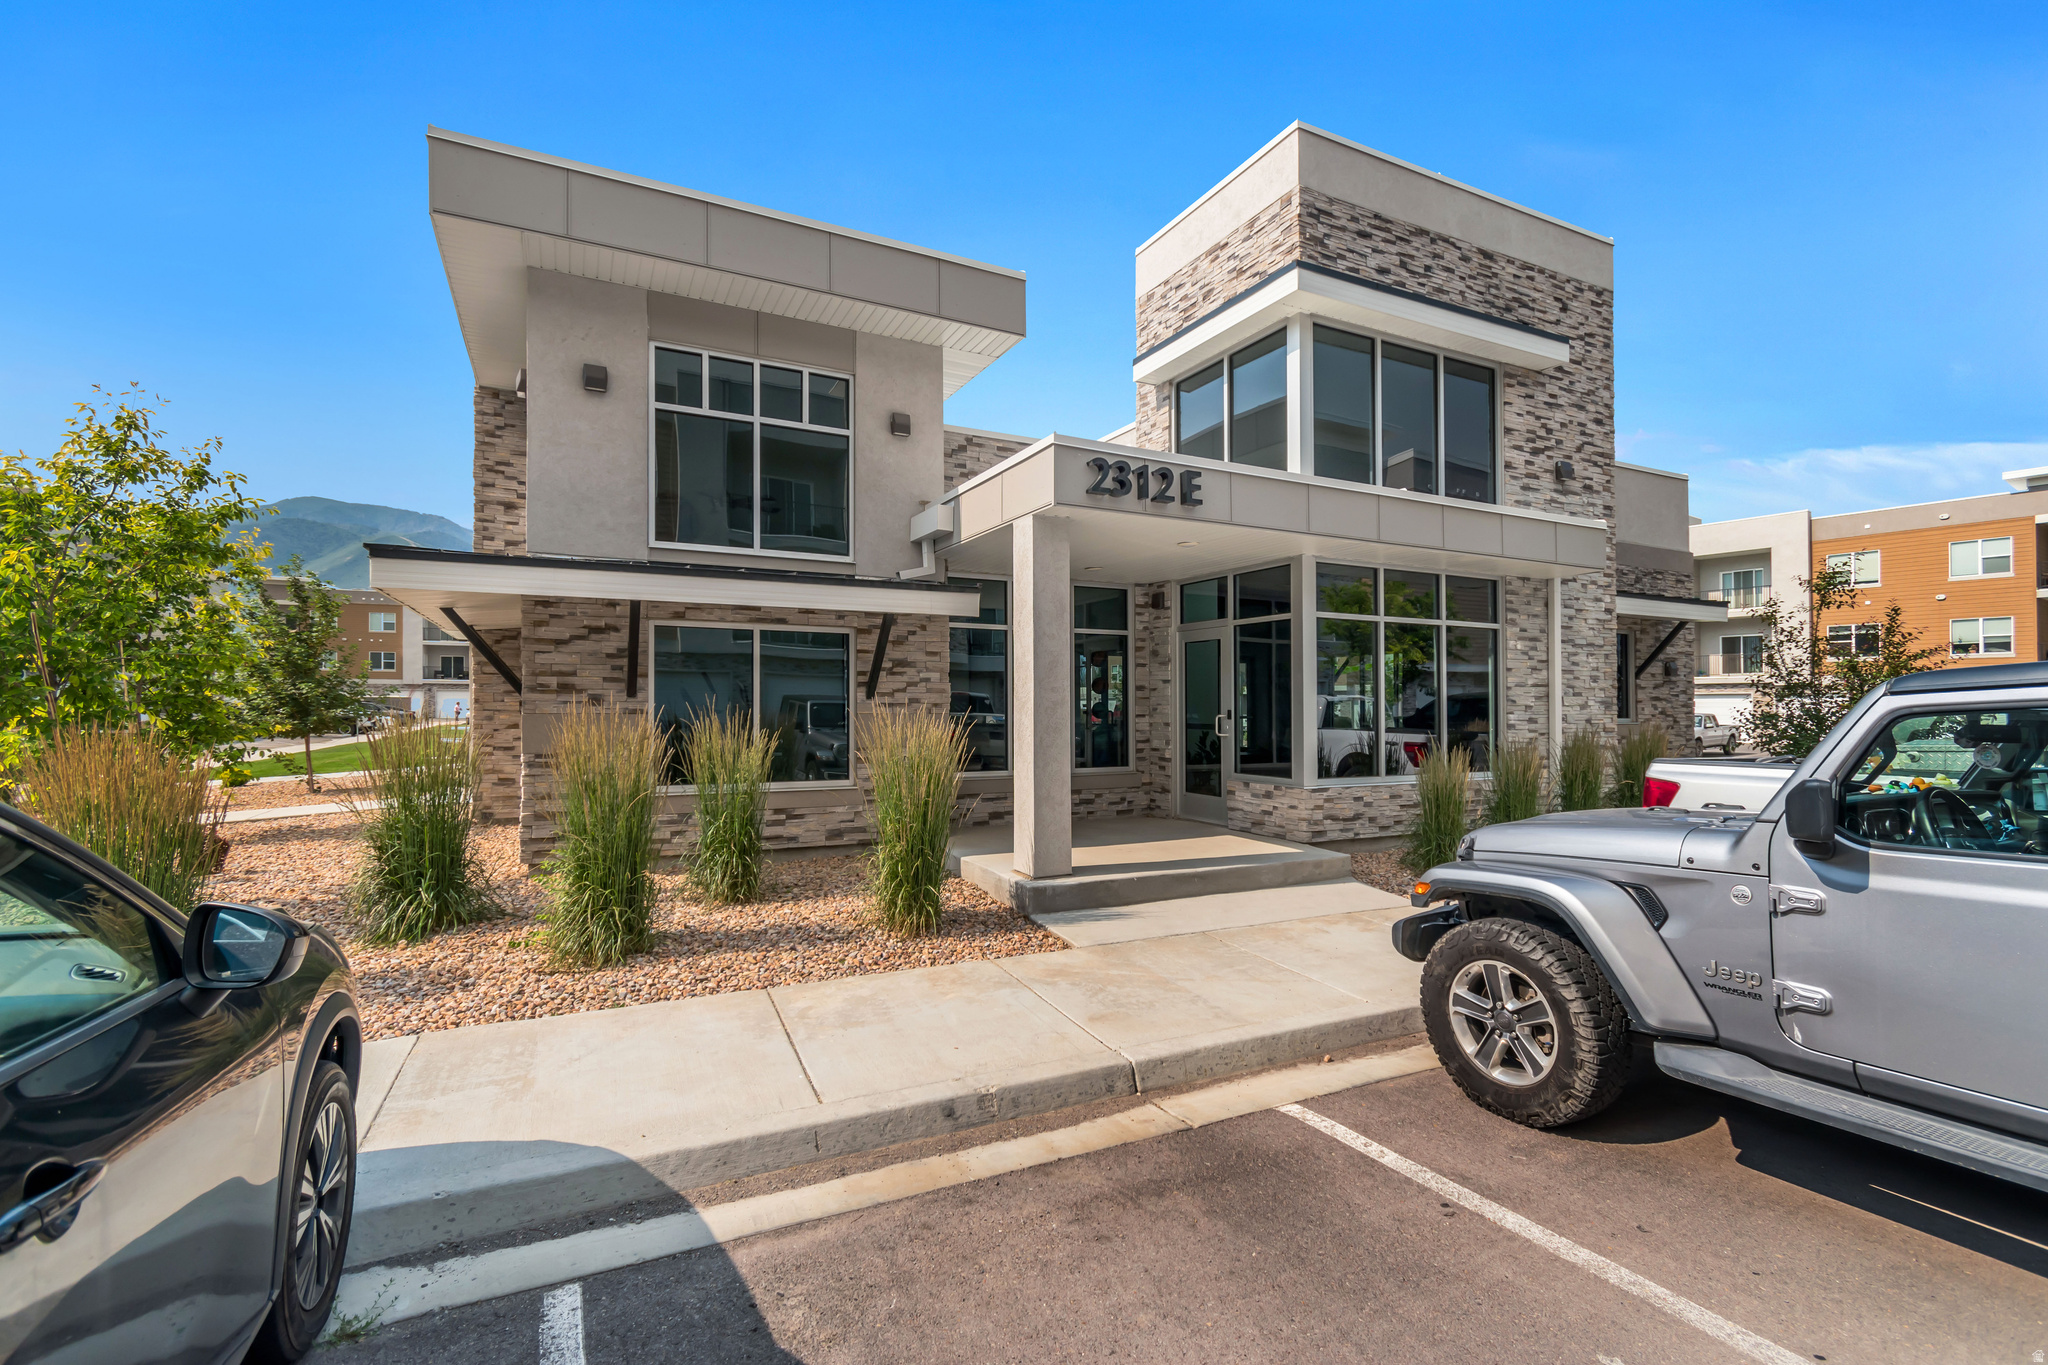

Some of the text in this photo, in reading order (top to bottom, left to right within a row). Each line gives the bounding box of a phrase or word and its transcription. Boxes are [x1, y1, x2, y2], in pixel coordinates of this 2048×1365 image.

[1086, 457, 1203, 507] 2312E
[1702, 960, 1762, 989] Jeep
[1703, 981, 1762, 999] WRANGLER
